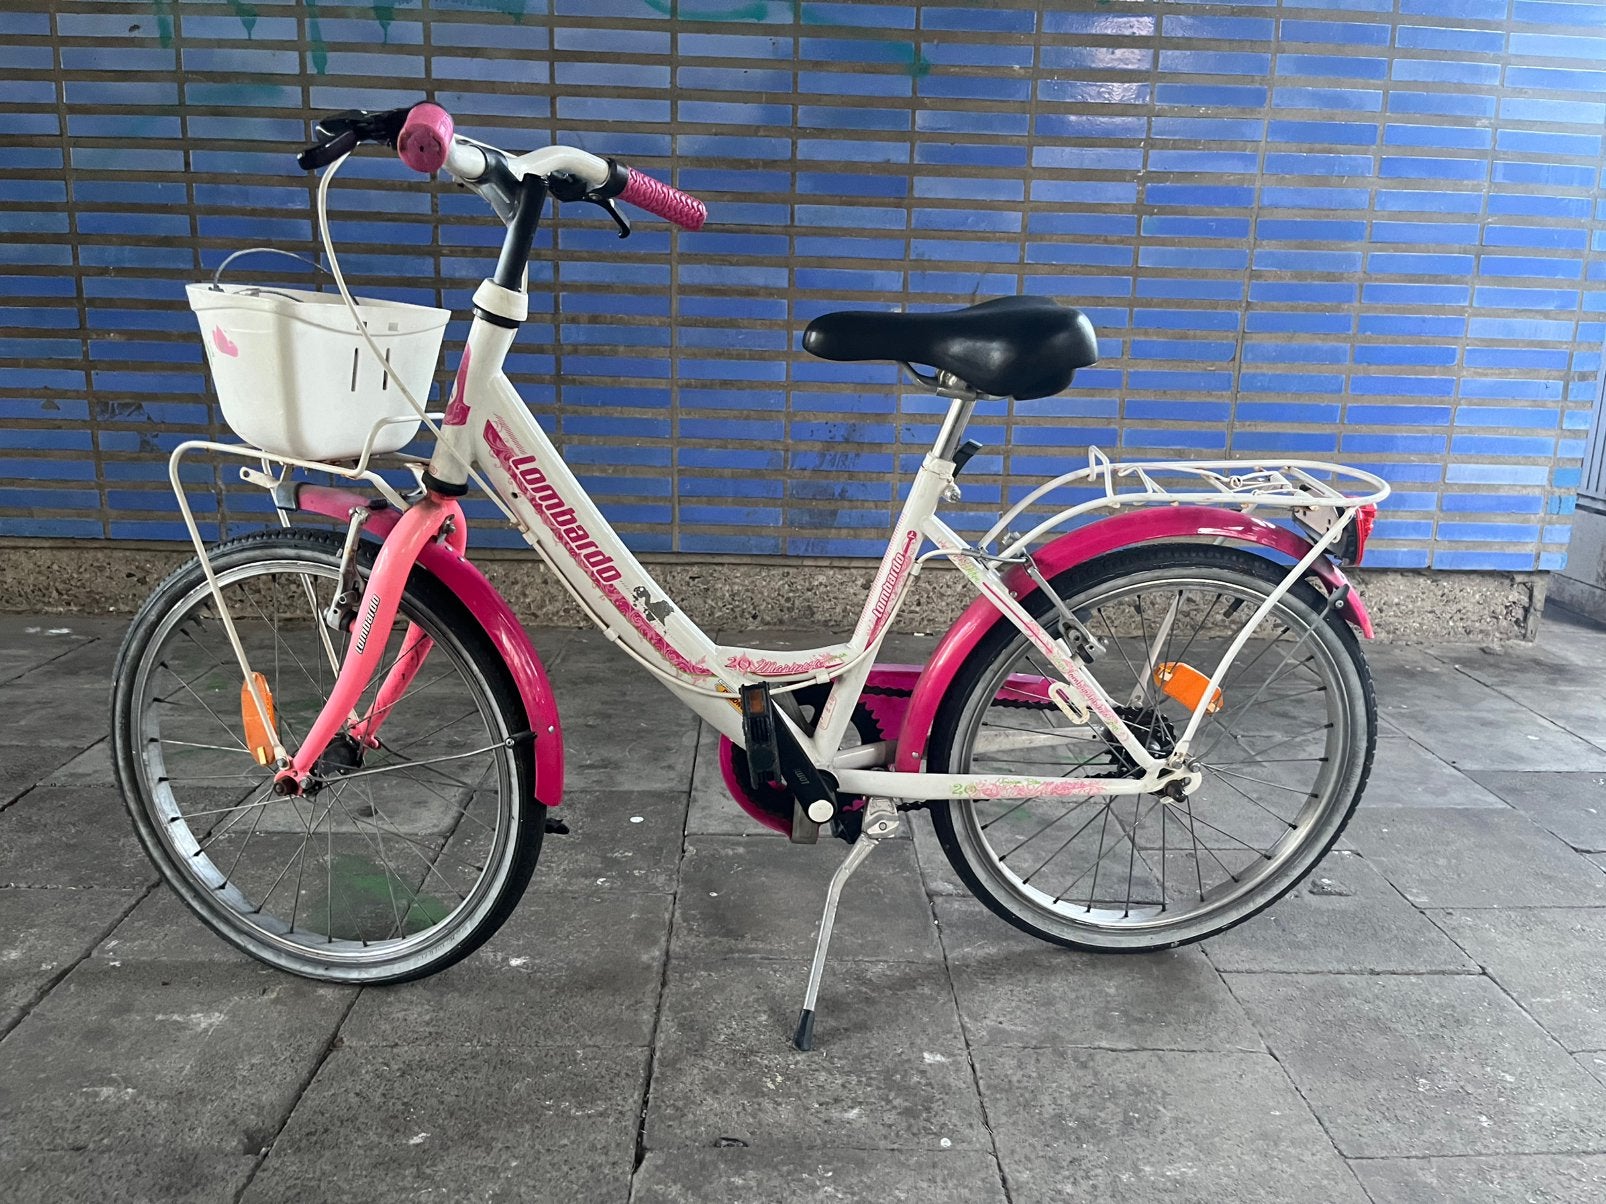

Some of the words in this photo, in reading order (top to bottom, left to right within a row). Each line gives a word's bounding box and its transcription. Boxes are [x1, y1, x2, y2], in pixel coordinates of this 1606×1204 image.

[509, 454, 622, 585] Lombardo
[872, 552, 905, 619] Lombardo
[355, 594, 380, 654] Lombardo
